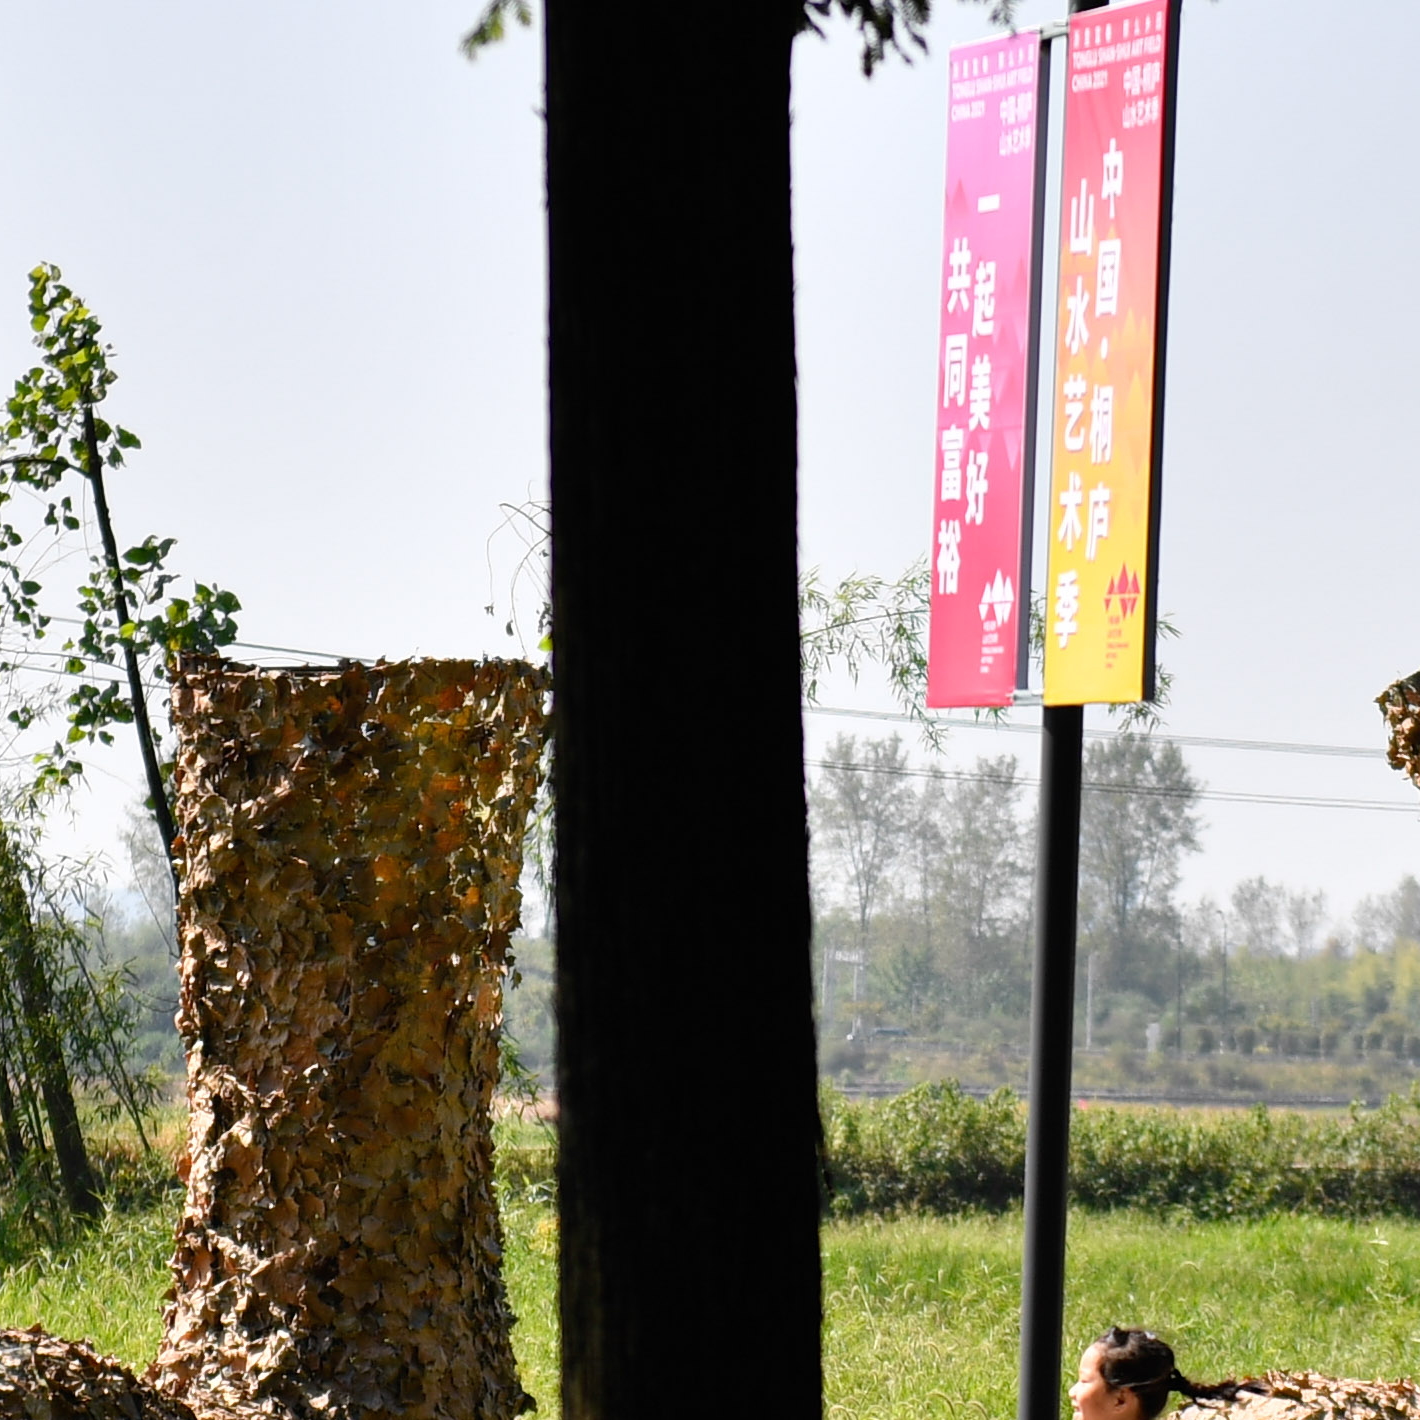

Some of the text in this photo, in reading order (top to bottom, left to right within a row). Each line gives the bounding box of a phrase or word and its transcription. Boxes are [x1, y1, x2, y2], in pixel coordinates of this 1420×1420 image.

[936, 236, 972, 595] 共同富裕
[965, 193, 1000, 526] 一起美好
[1054, 178, 1095, 649] 山水艺术季
